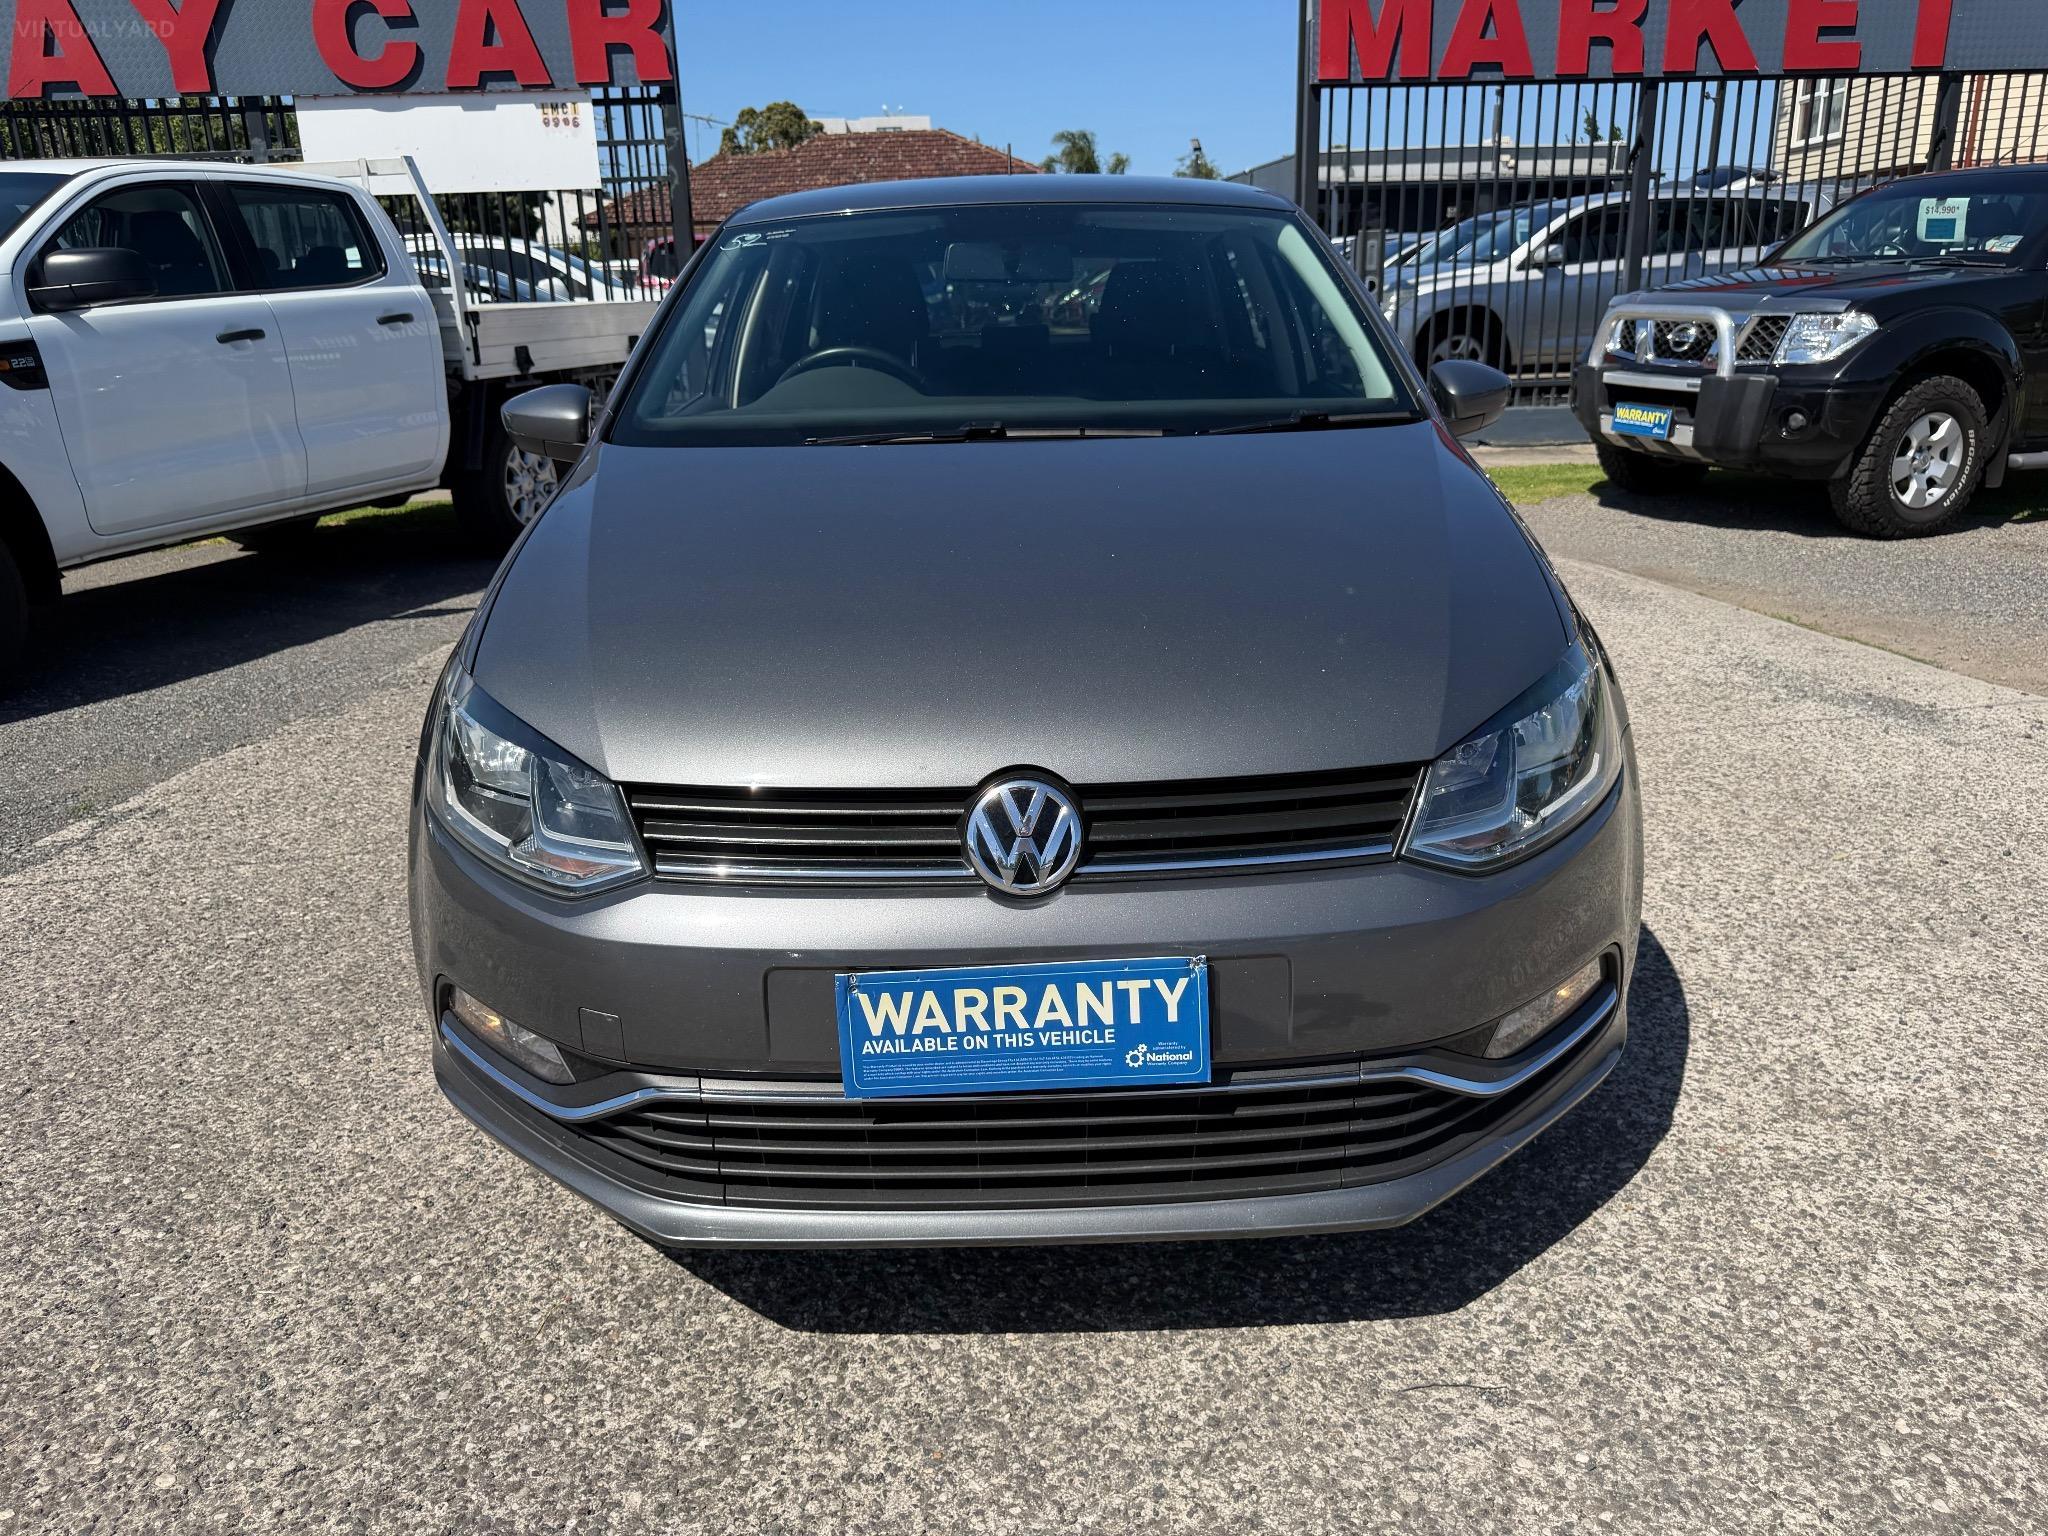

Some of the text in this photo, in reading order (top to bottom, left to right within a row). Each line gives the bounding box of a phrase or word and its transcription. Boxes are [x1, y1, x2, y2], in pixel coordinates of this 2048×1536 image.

[312, 0, 673, 88] CAR
[541, 102, 579, 115] LMCT
[1616, 407, 1668, 425] WARRANTY
[857, 977, 1190, 1037] WARRANTY
[861, 1028, 1116, 1055] AVAILABLE ON THIS VEHICLE
[1146, 1050, 1193, 1061] National
